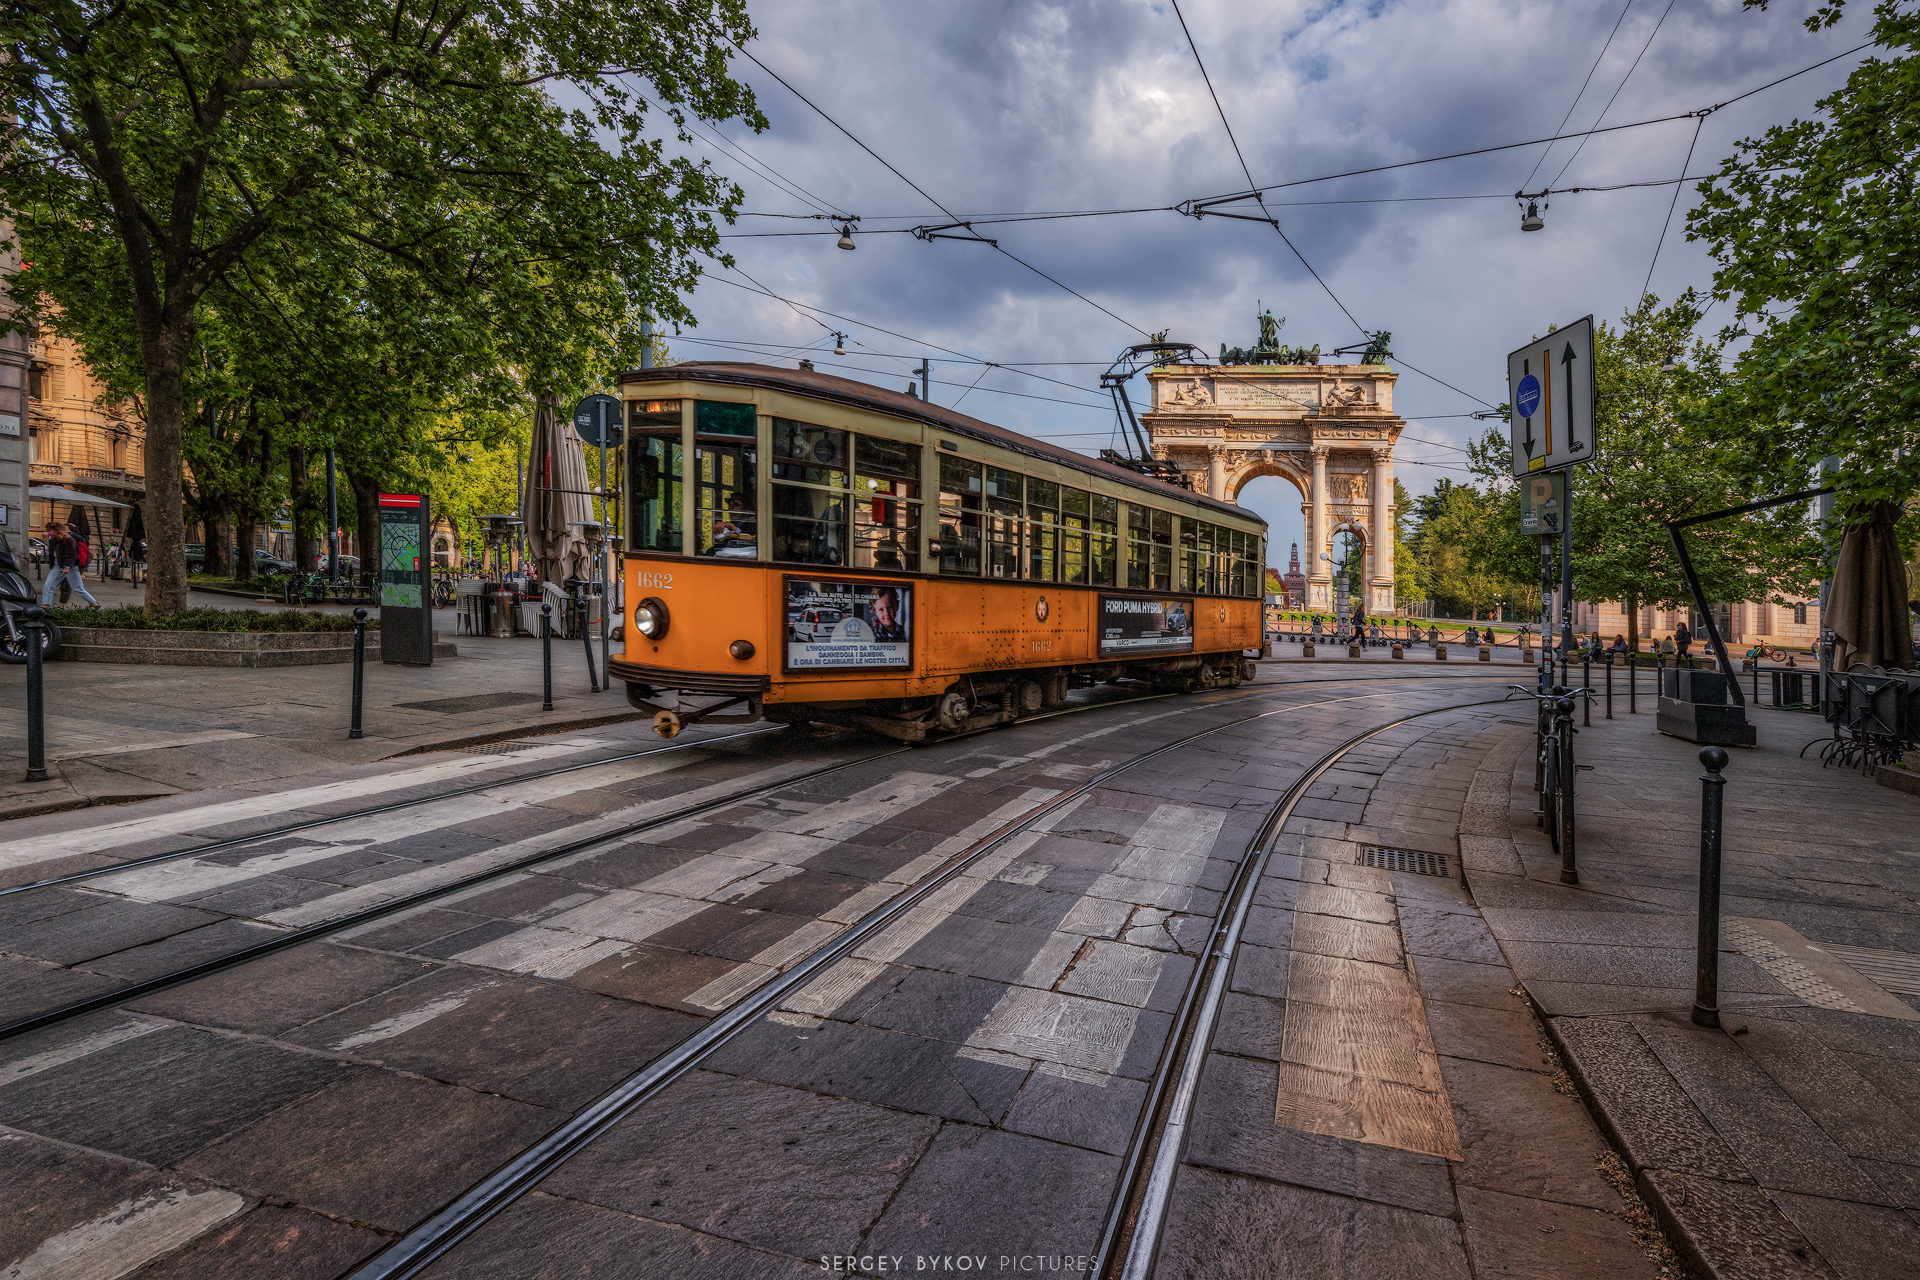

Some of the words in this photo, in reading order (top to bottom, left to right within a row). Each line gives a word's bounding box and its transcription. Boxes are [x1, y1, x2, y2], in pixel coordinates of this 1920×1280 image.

[1531, 478, 1552, 518] P
[638, 571, 673, 590] 1662
[1106, 600, 1123, 613] FORD
[1124, 601, 1141, 613] PUMA
[1142, 602, 1162, 613] HYBRID
[1032, 640, 1052, 652] 1662
